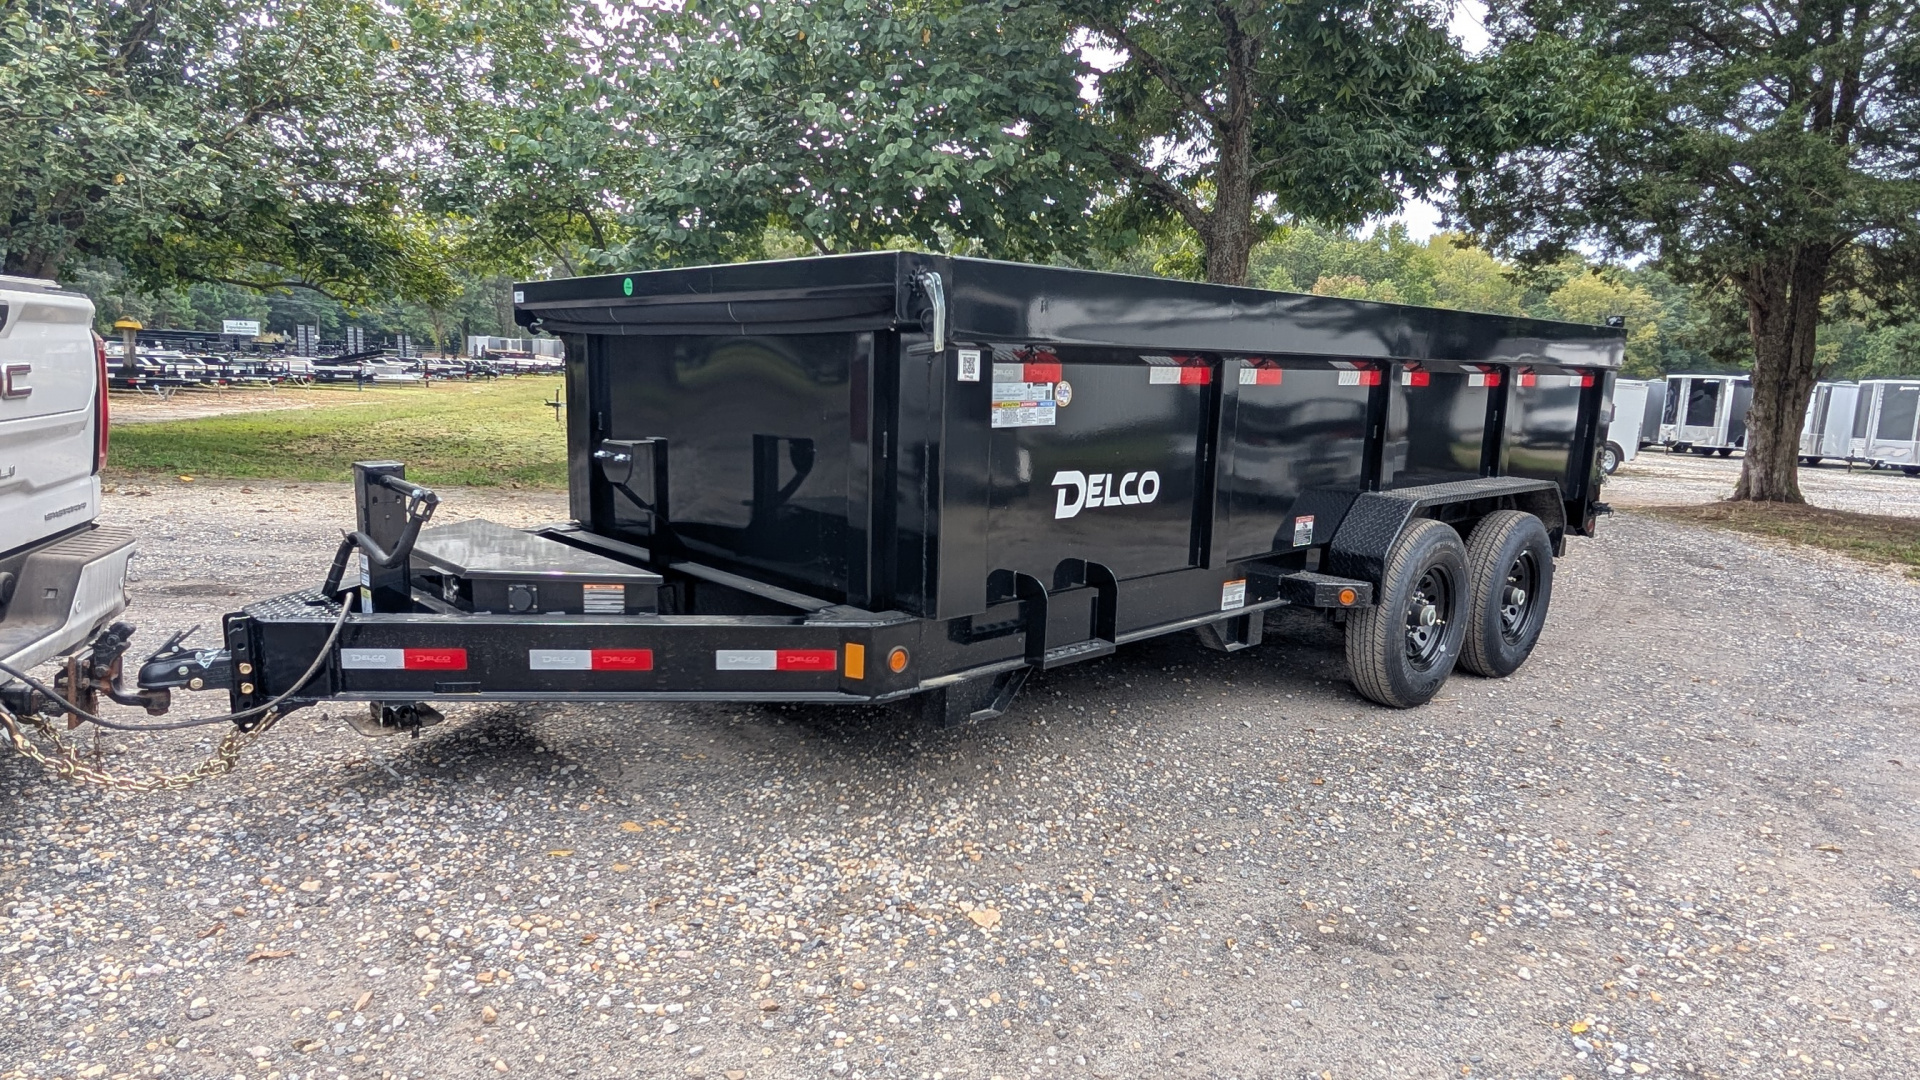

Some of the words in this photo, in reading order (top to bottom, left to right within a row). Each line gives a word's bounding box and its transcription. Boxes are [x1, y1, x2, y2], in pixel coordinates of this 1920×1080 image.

[0, 362, 33, 399] C
[1051, 470, 1160, 519] DELCO
[350, 653, 387, 663] DELCO
[415, 654, 451, 663] DELCO
[541, 655, 577, 664] DELCO
[601, 655, 637, 664] DELCO
[728, 655, 761, 664] DELCO
[786, 655, 820, 664] DELCO
